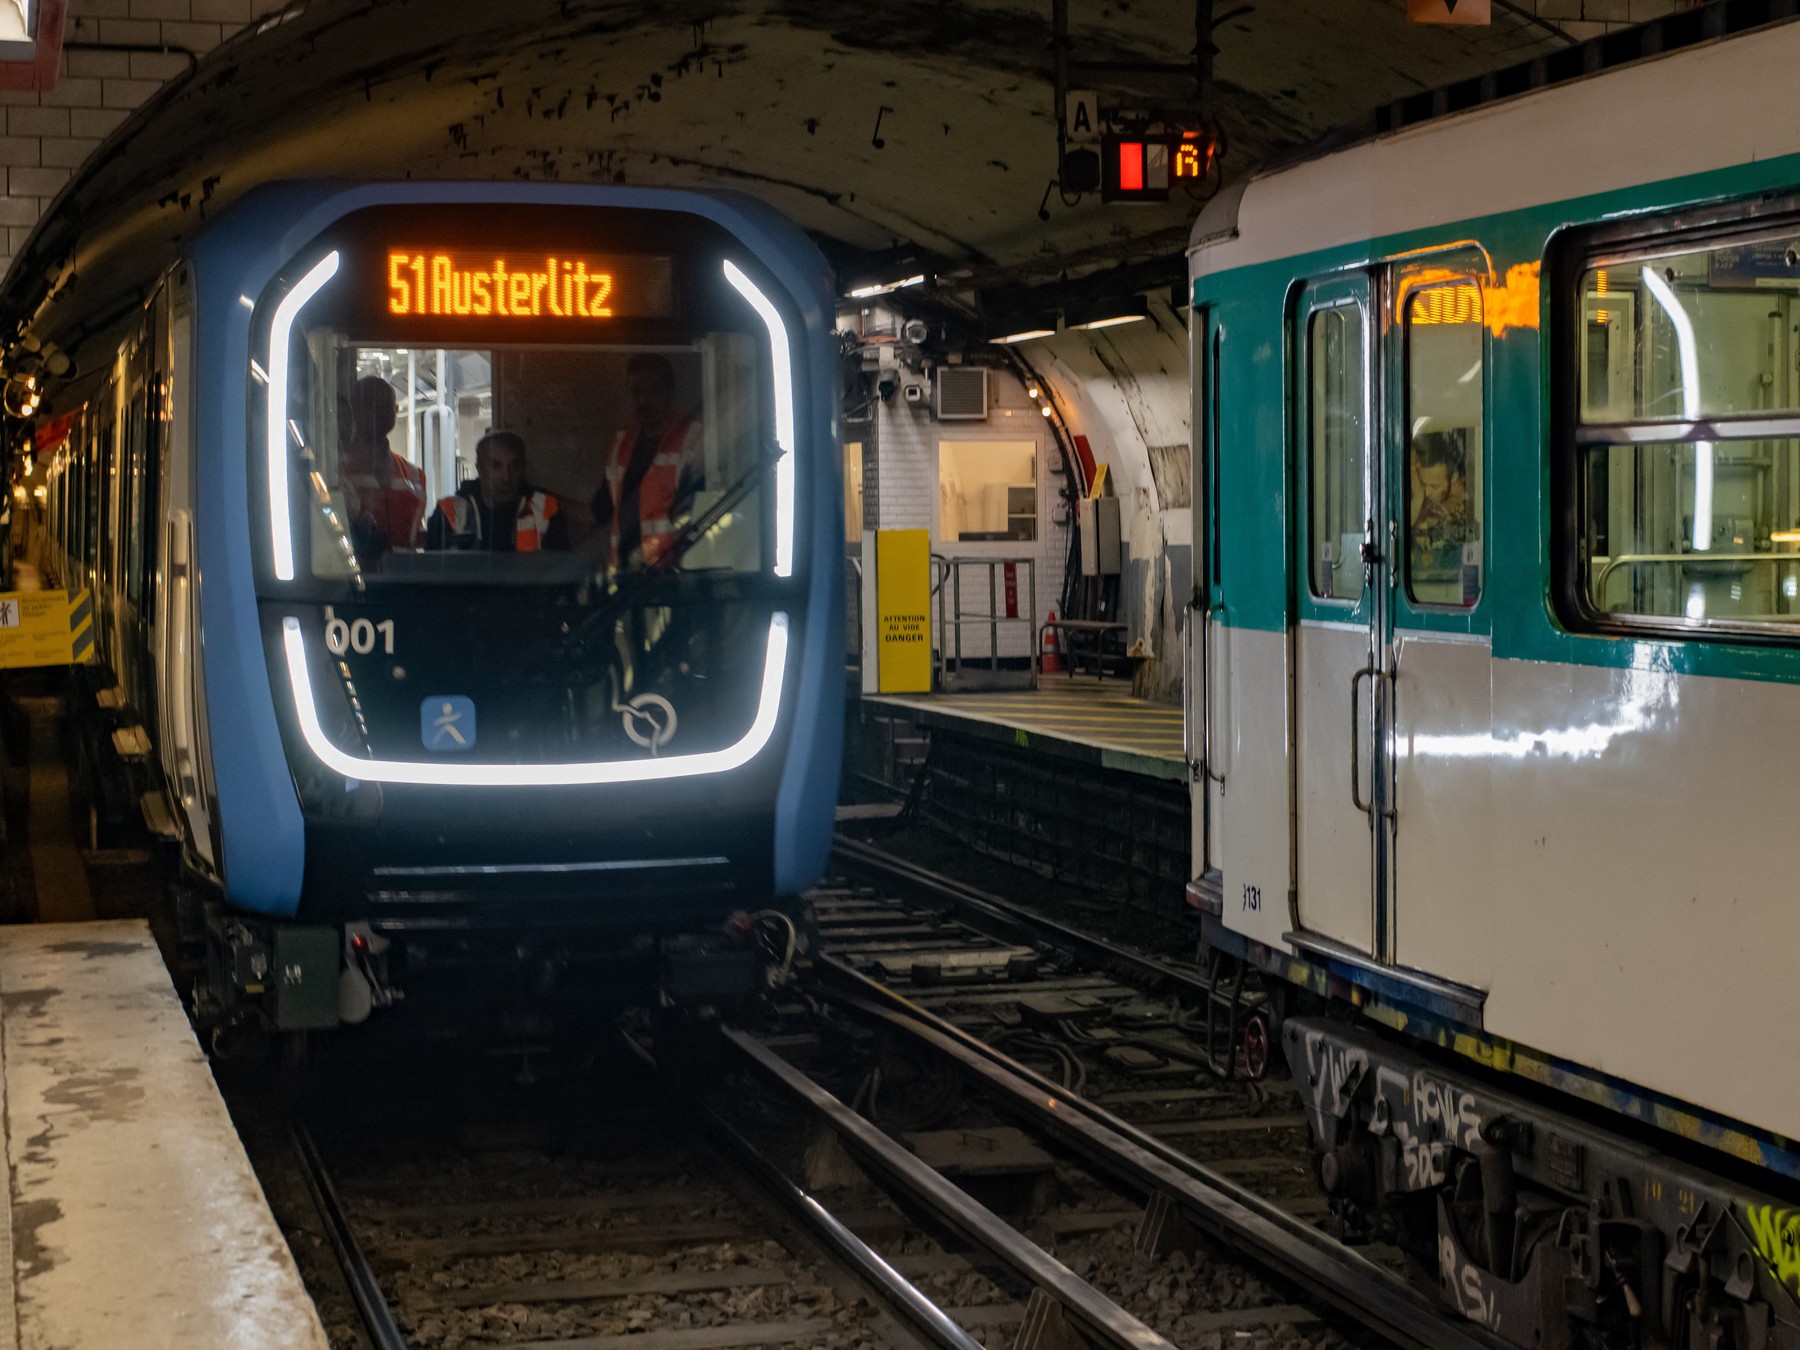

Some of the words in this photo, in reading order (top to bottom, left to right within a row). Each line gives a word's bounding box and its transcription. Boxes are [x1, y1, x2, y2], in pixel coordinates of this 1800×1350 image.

[1073, 101, 1092, 133] A
[325, 618, 395, 656] 001
[885, 634, 924, 643] DANGER
